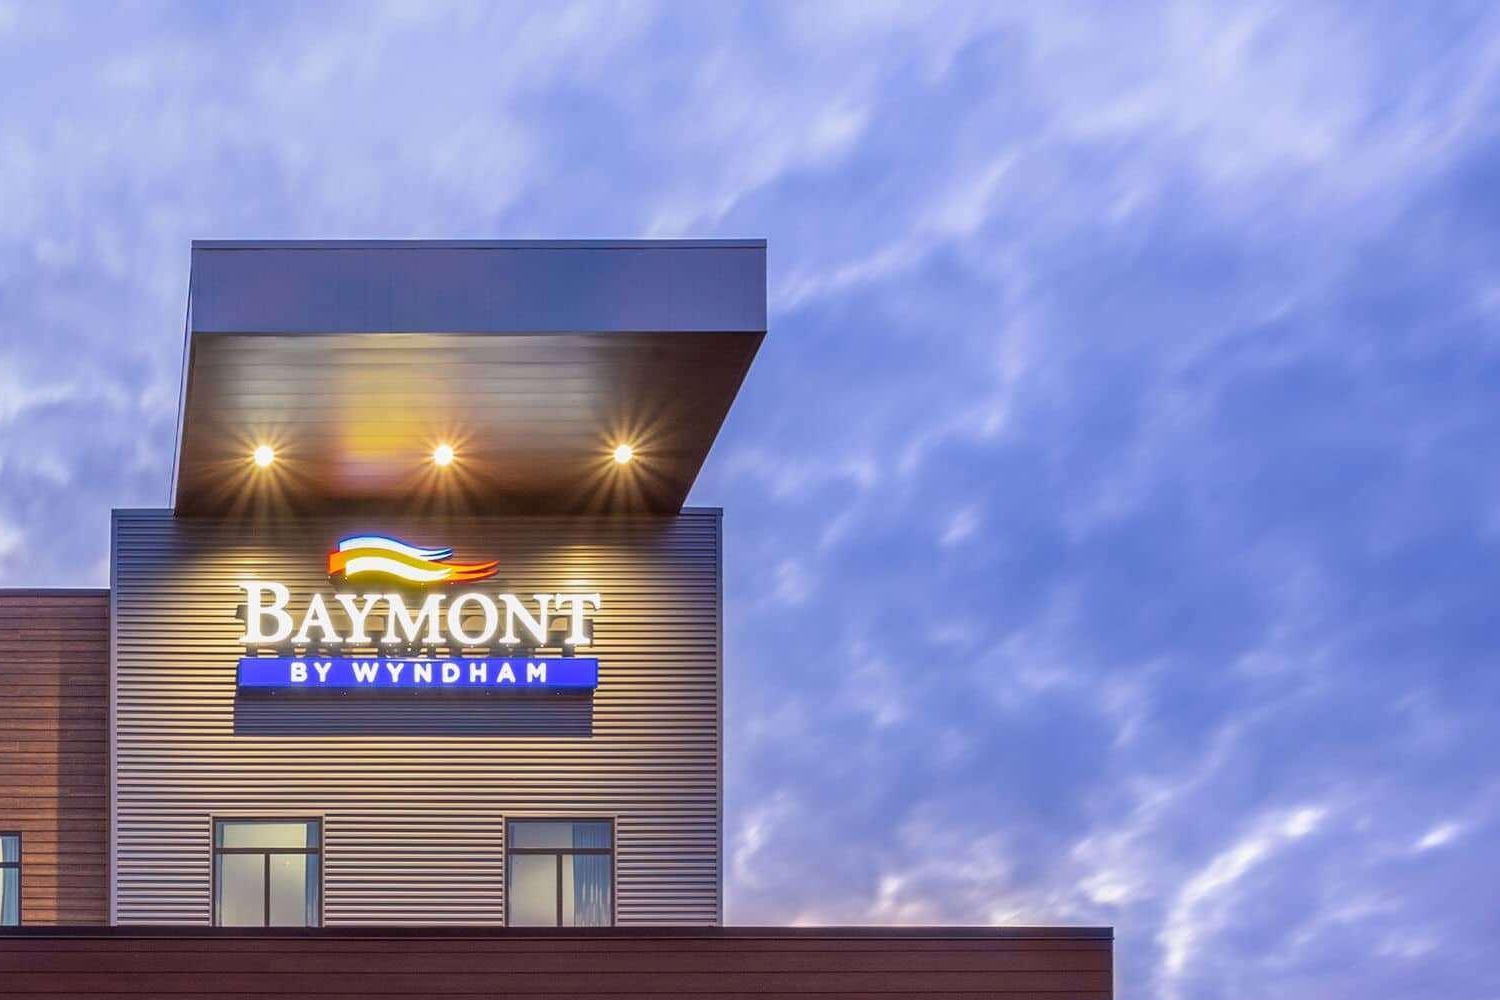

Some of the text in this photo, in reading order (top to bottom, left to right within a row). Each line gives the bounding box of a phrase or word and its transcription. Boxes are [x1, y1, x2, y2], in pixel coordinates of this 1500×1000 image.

[238, 582, 601, 645] BAYMONT
[290, 662, 547, 684] BY WYNDHAM
